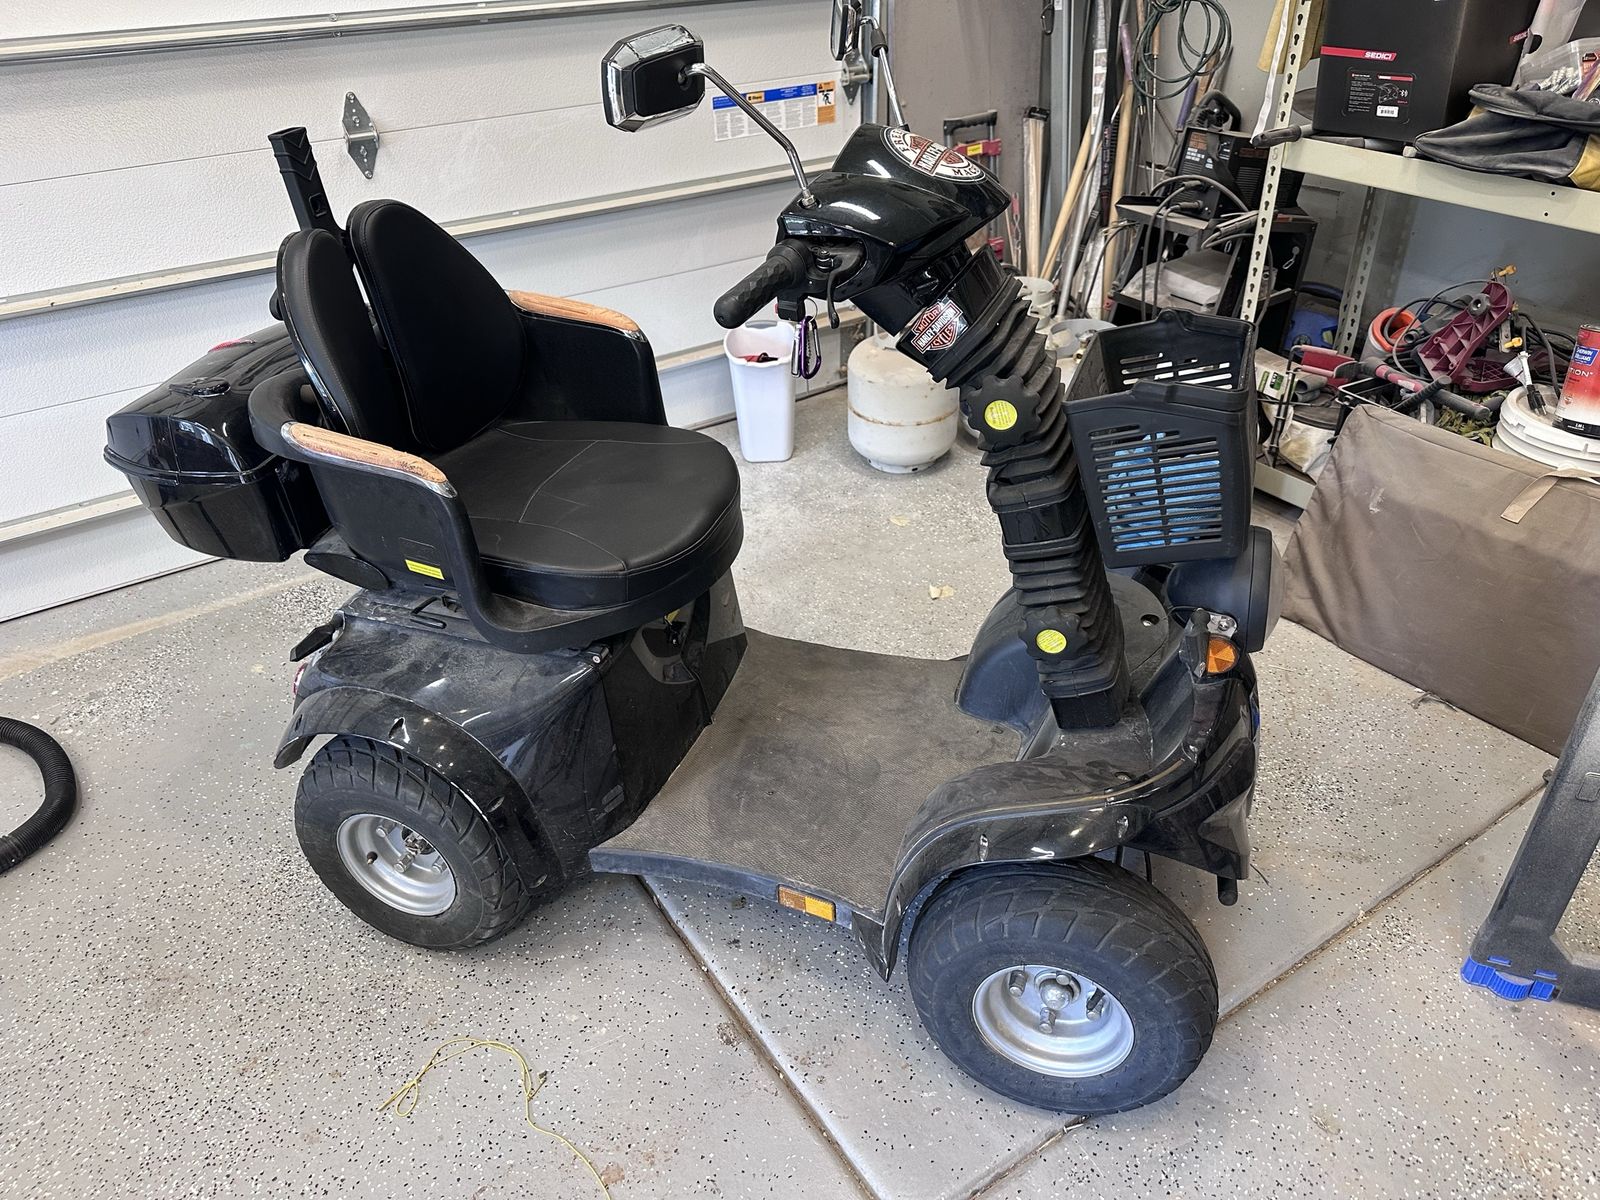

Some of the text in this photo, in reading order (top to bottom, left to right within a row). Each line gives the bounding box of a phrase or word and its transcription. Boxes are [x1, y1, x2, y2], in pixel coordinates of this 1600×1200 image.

[1364, 51, 1392, 60] SEDICI
[916, 306, 957, 348] HARLEY-DAVIDSON
[918, 309, 940, 332] MOTOR
[933, 324, 953, 346] CYCLES
